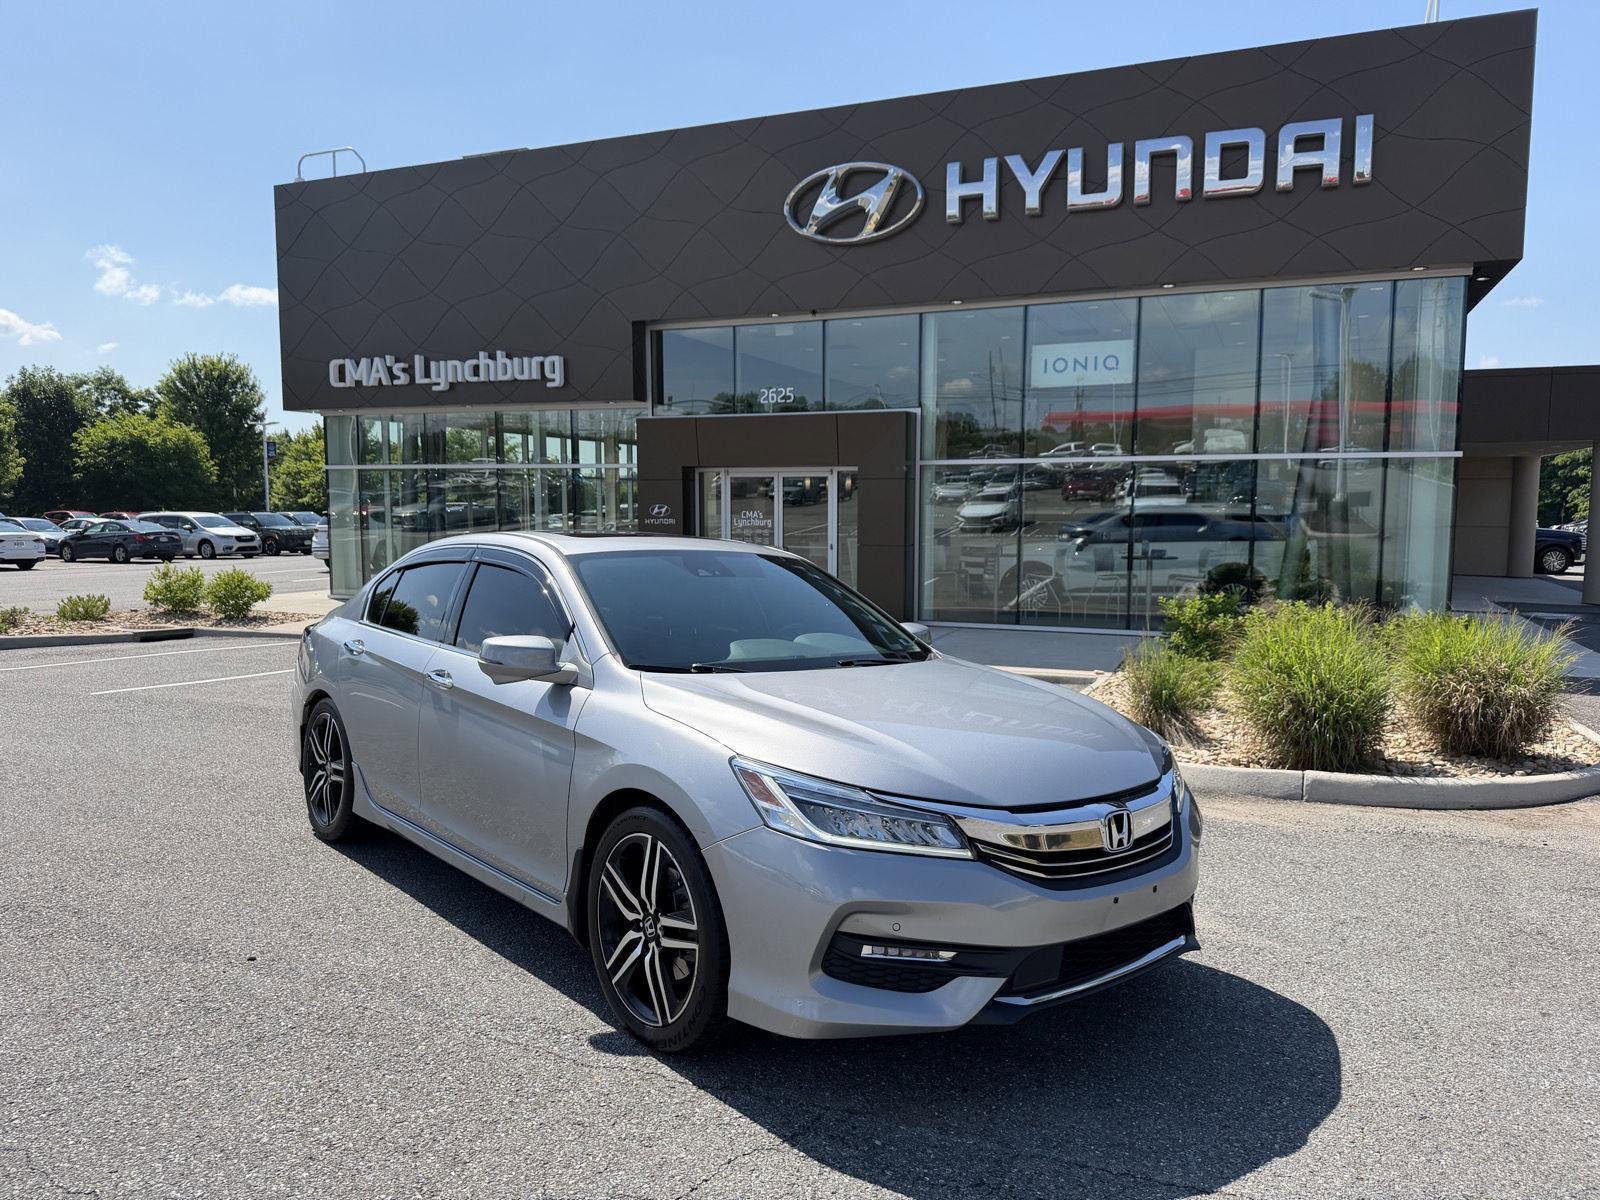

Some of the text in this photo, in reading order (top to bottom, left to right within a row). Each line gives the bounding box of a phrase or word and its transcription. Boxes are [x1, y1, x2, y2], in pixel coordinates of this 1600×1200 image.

[945, 113, 1376, 225] HYUNDAI
[328, 350, 565, 392] CMA's Lynchburg
[1043, 354, 1120, 374] IONIQ
[760, 387, 794, 404] 2625
[733, 518, 772, 528] Lynchburg
[741, 510, 763, 519] CMA's
